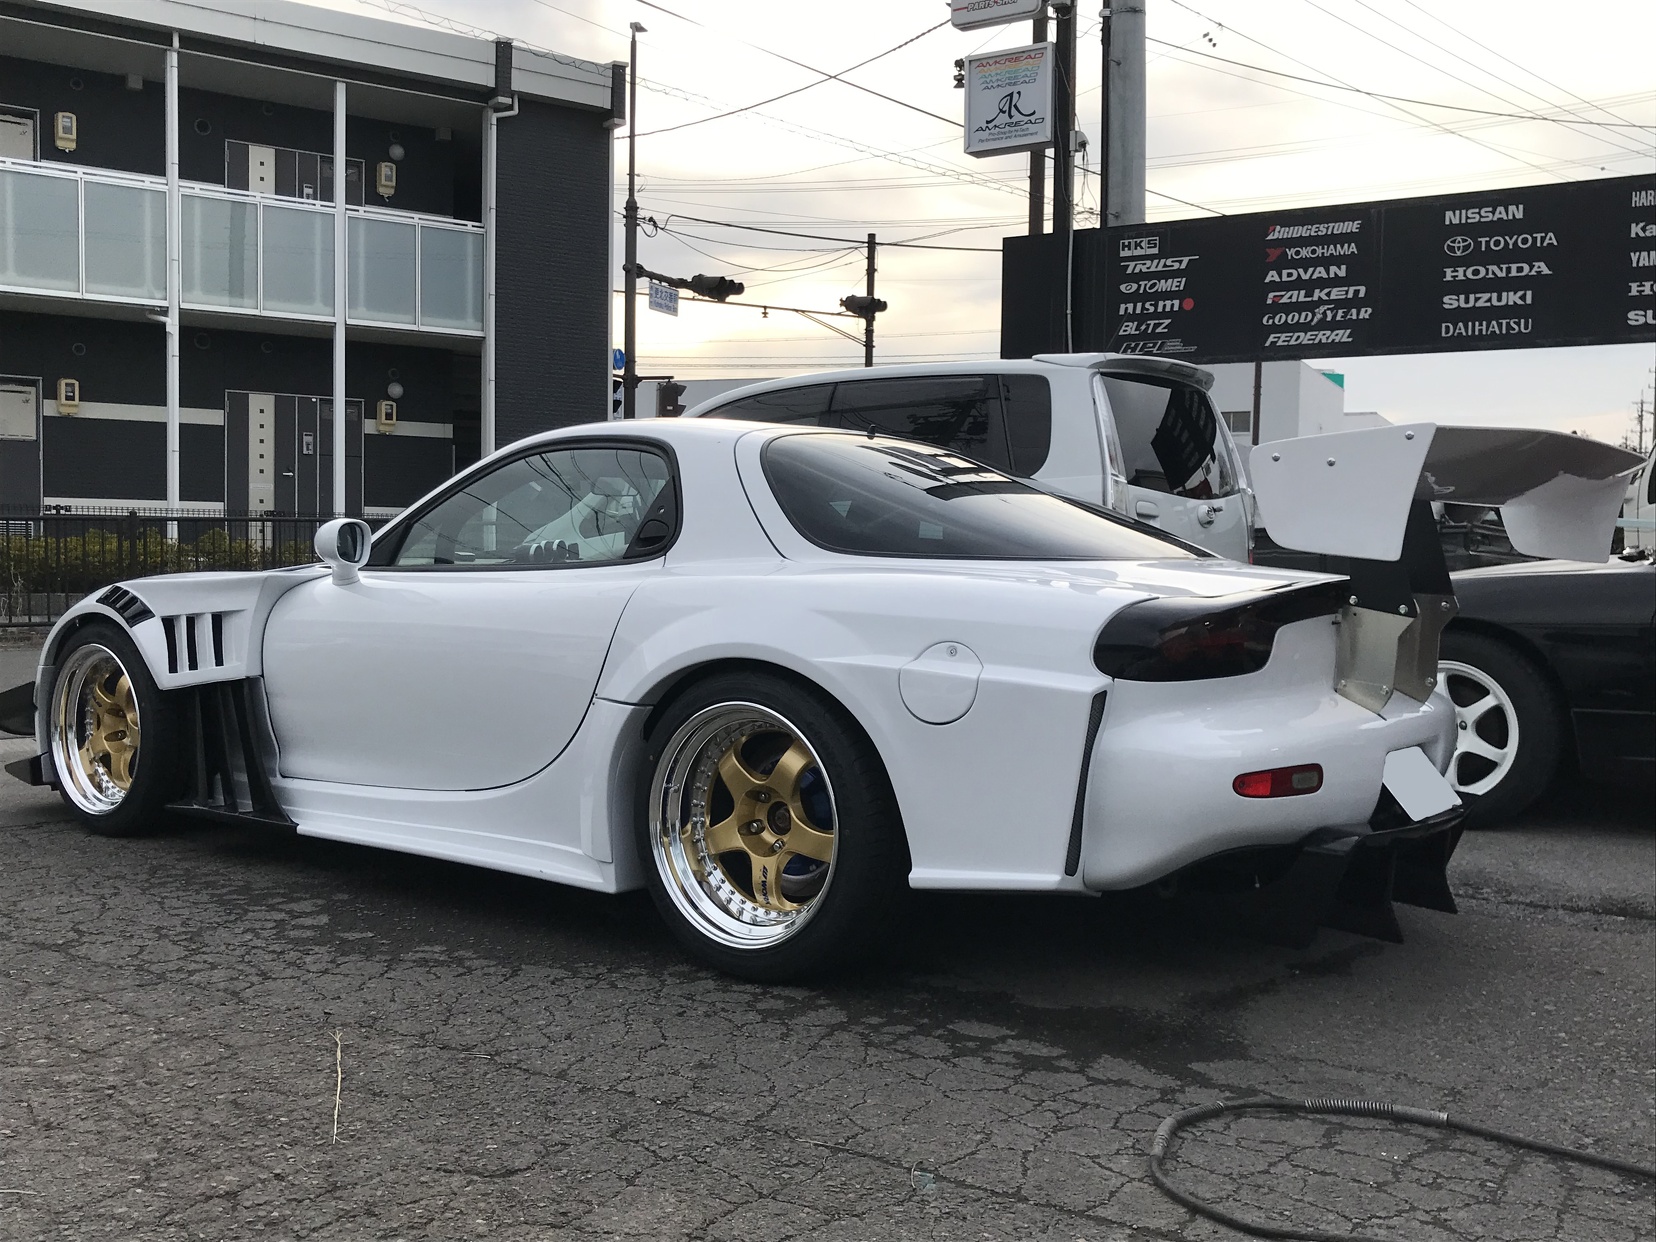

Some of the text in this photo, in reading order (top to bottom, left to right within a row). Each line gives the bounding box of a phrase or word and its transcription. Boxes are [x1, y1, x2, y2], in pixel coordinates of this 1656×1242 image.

[967, 0, 995, 12] PARTS
[975, 52, 1044, 69] AMKREAD
[982, 78, 1036, 91] AMKREAD
[974, 117, 1044, 133] AMKREAD
[1631, 189, 1656, 207] HAR
[1444, 204, 1524, 225] NISSAN
[1265, 220, 1361, 240] BRIDGESTONE
[1120, 237, 1158, 254] HKS
[1478, 232, 1558, 251] TOYOTA
[1286, 243, 1358, 259] YOKOHAMA
[1120, 256, 1199, 274] TRUST
[1264, 265, 1347, 283] ADVAN
[1443, 261, 1553, 281] HONDA
[1139, 278, 1186, 296] TOMEI
[1266, 286, 1366, 304] FALKEN
[1628, 281, 1656, 296] H
[1442, 290, 1532, 310] SUZUKI
[1441, 318, 1532, 337] DAIHATSU
[1264, 329, 1353, 347] FEDERAL
